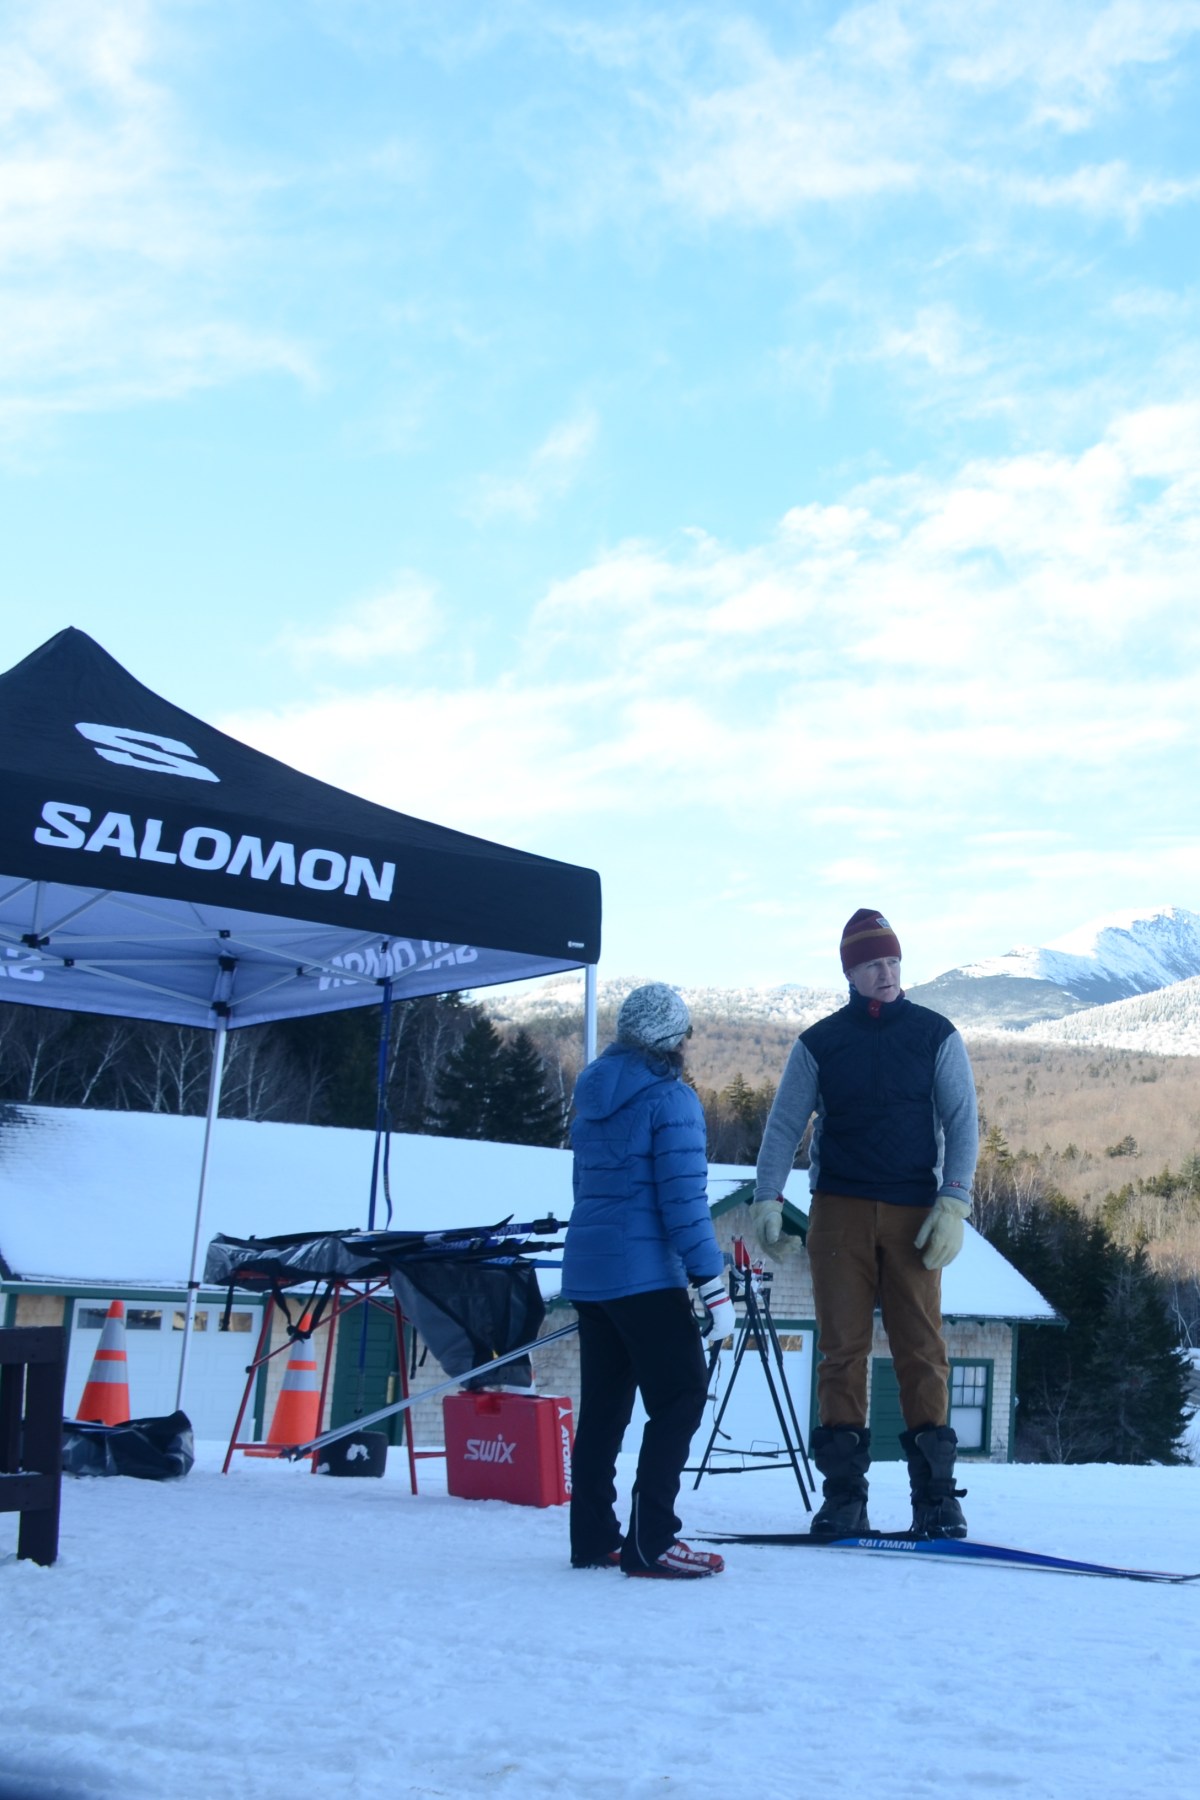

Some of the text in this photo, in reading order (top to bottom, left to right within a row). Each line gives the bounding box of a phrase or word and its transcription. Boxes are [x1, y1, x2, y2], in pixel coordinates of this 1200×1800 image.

[34, 801, 396, 901] SALOMON
[561, 1425, 573, 1494] ATOMIC
[857, 1538, 917, 1550] SALOMON
